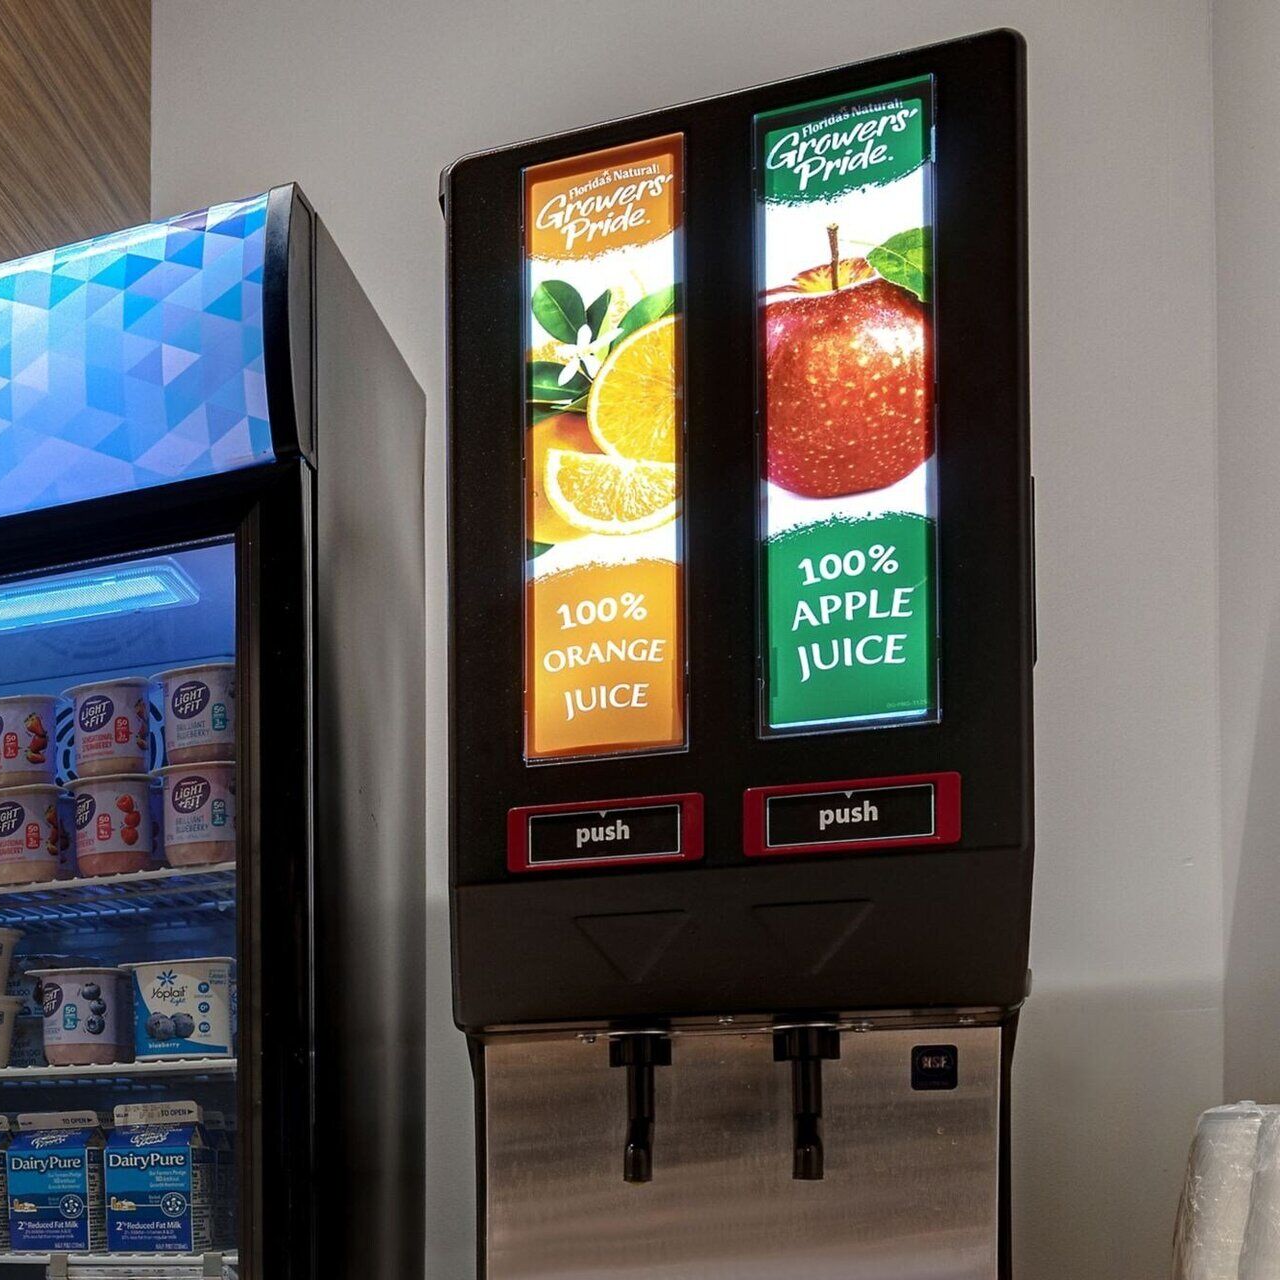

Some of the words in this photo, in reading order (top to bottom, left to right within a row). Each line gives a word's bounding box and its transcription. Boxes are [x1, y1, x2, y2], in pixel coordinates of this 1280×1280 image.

[766, 108, 919, 170] Growers'
[536, 174, 674, 230] Growers'
[797, 544, 899, 586] 100%
[556, 592, 648, 630] 100%
[791, 586, 915, 633] APPLE
[543, 638, 667, 673] ORANGE
[796, 633, 908, 683] JUICE
[564, 682, 649, 721] JUICE
[818, 801, 880, 831] push
[576, 821, 631, 848] push
[151, 986, 185, 1001] Yoplait
[161, 1109, 169, 1117] TO
[170, 1108, 187, 1116] OPEN
[11, 1156, 81, 1173] DairyPure
[109, 1153, 185, 1169] DairyPure
[27, 1221, 54, 1229] Reduced
[54, 1221, 64, 1229] Fat
[64, 1221, 79, 1229] Milk
[126, 1221, 155, 1229] Reduced
[156, 1221, 166, 1229] Fat
[167, 1221, 182, 1229] Milk
